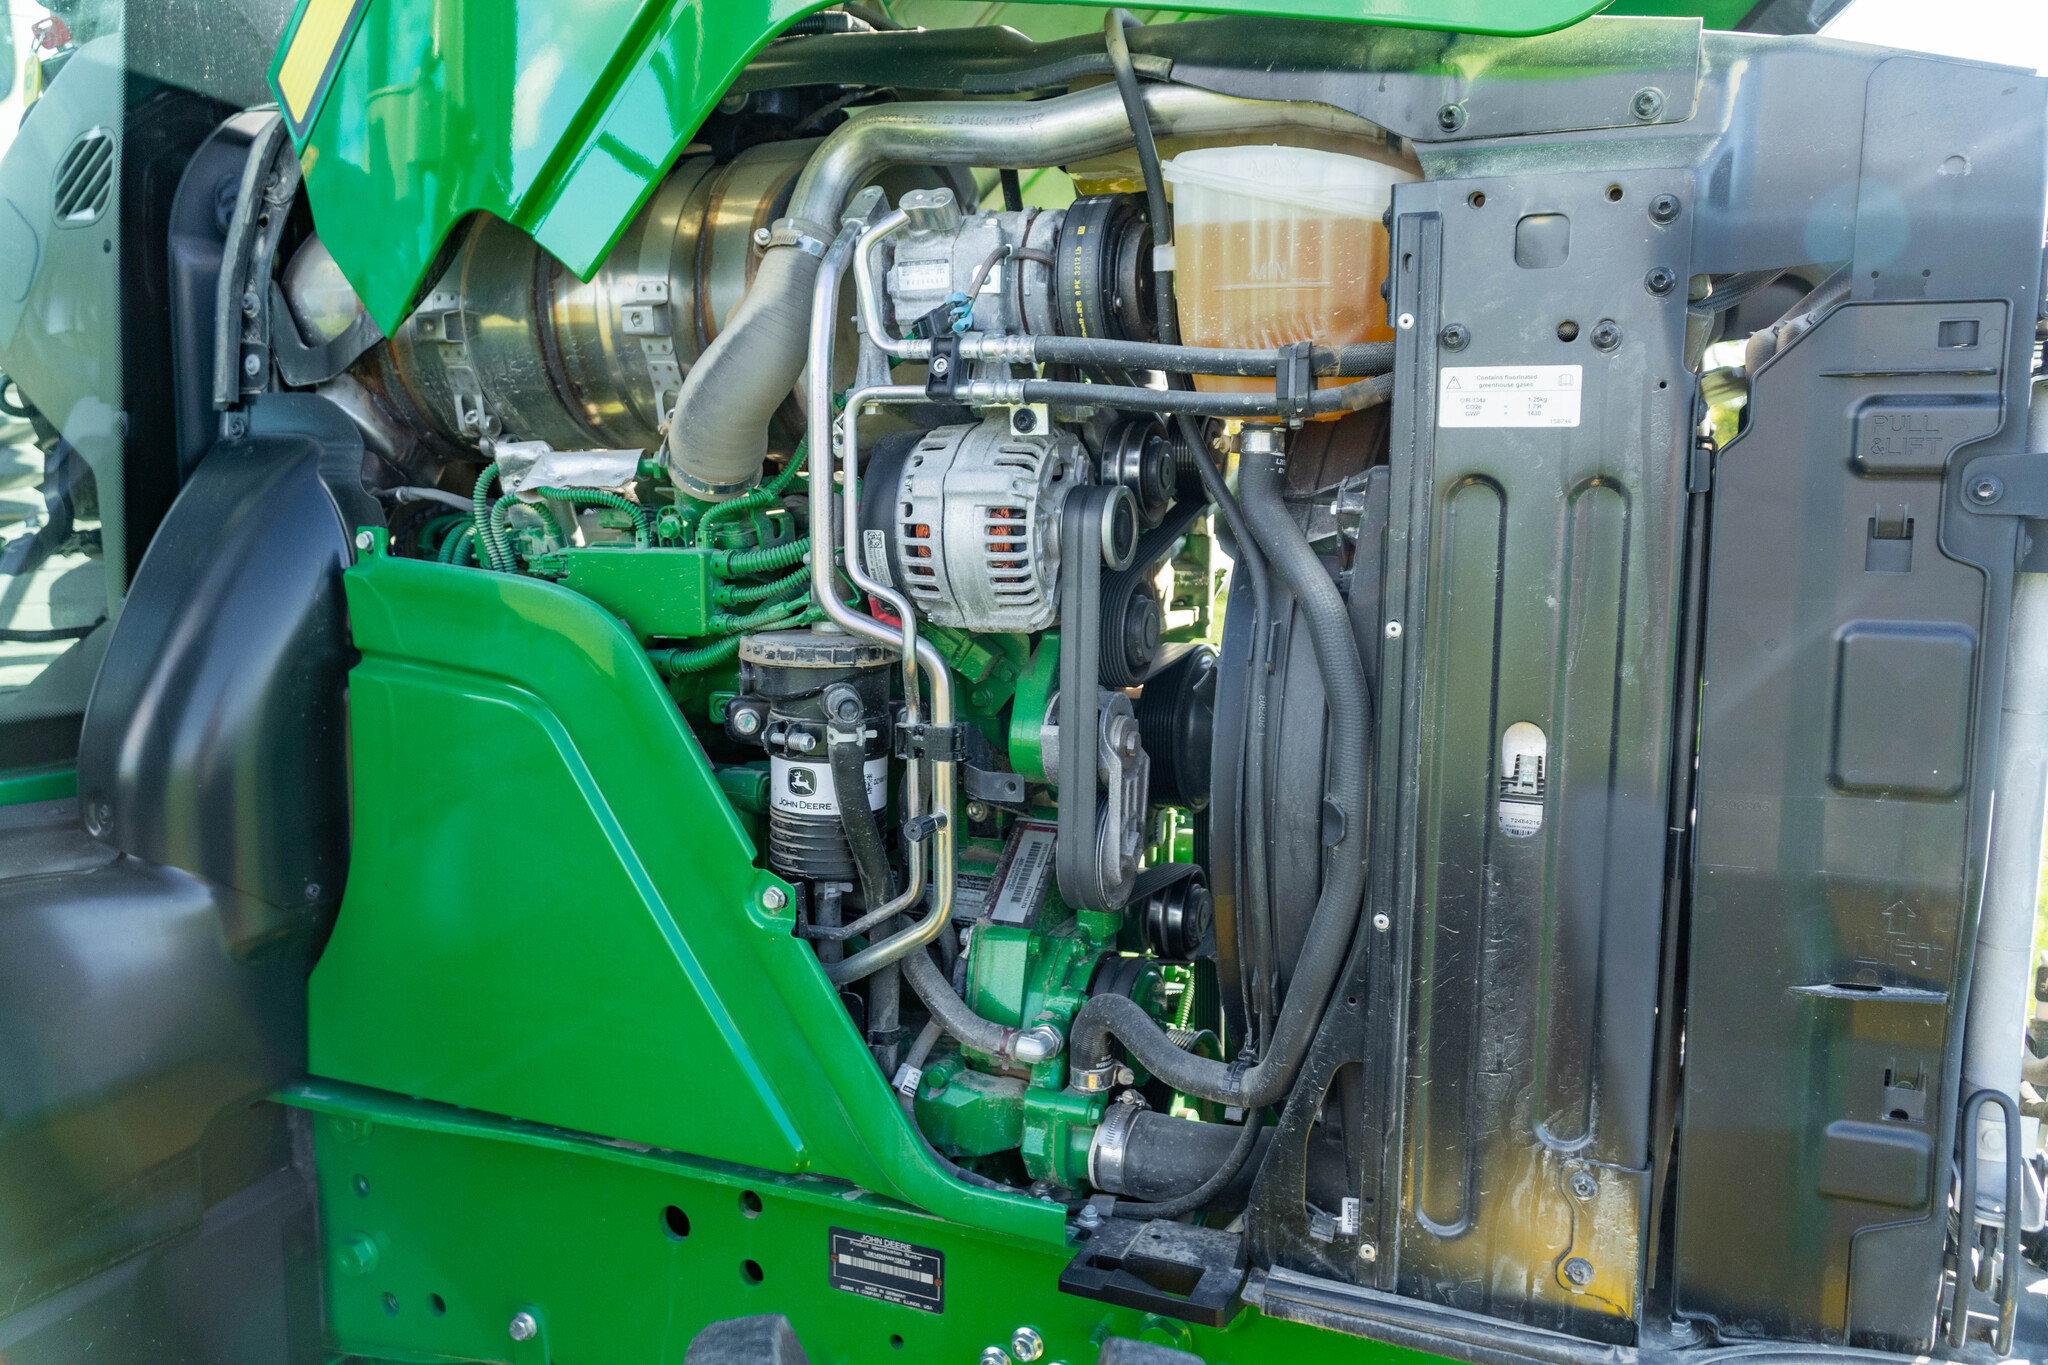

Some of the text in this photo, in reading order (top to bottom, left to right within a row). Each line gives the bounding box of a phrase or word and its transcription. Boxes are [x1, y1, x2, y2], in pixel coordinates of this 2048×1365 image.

[1074, 257, 1082, 276] 3212
[1250, 261, 1288, 281] MIN
[1872, 415, 1940, 433] PULL
[779, 797, 832, 810] JOHN DEERE
[861, 1234, 912, 1251] JOHN DEERE
